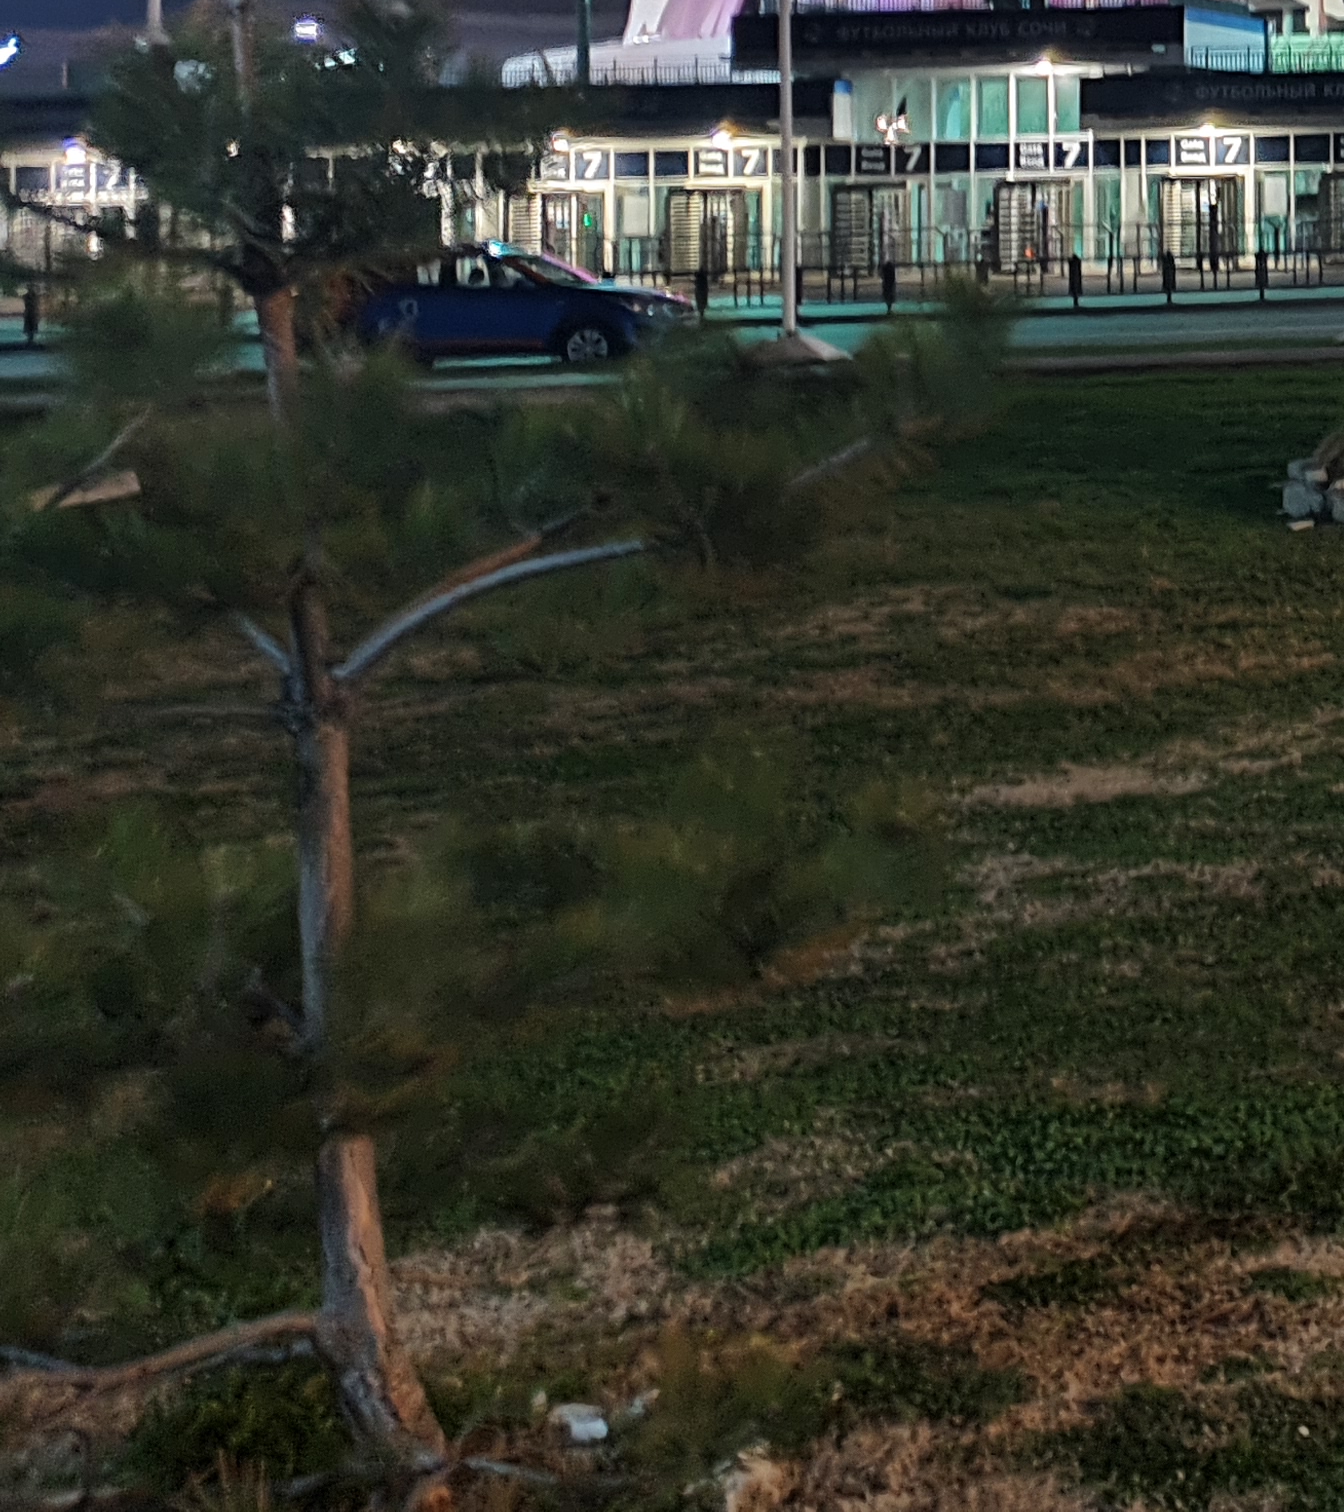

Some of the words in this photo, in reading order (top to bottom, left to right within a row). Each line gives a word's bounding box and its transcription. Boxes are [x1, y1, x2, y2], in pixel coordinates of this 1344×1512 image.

[741, 149, 760, 175] 7
[904, 145, 921, 171] 7
[1062, 140, 1080, 169] 7
[1223, 136, 1241, 163] 7
[583, 151, 602, 179] 7
